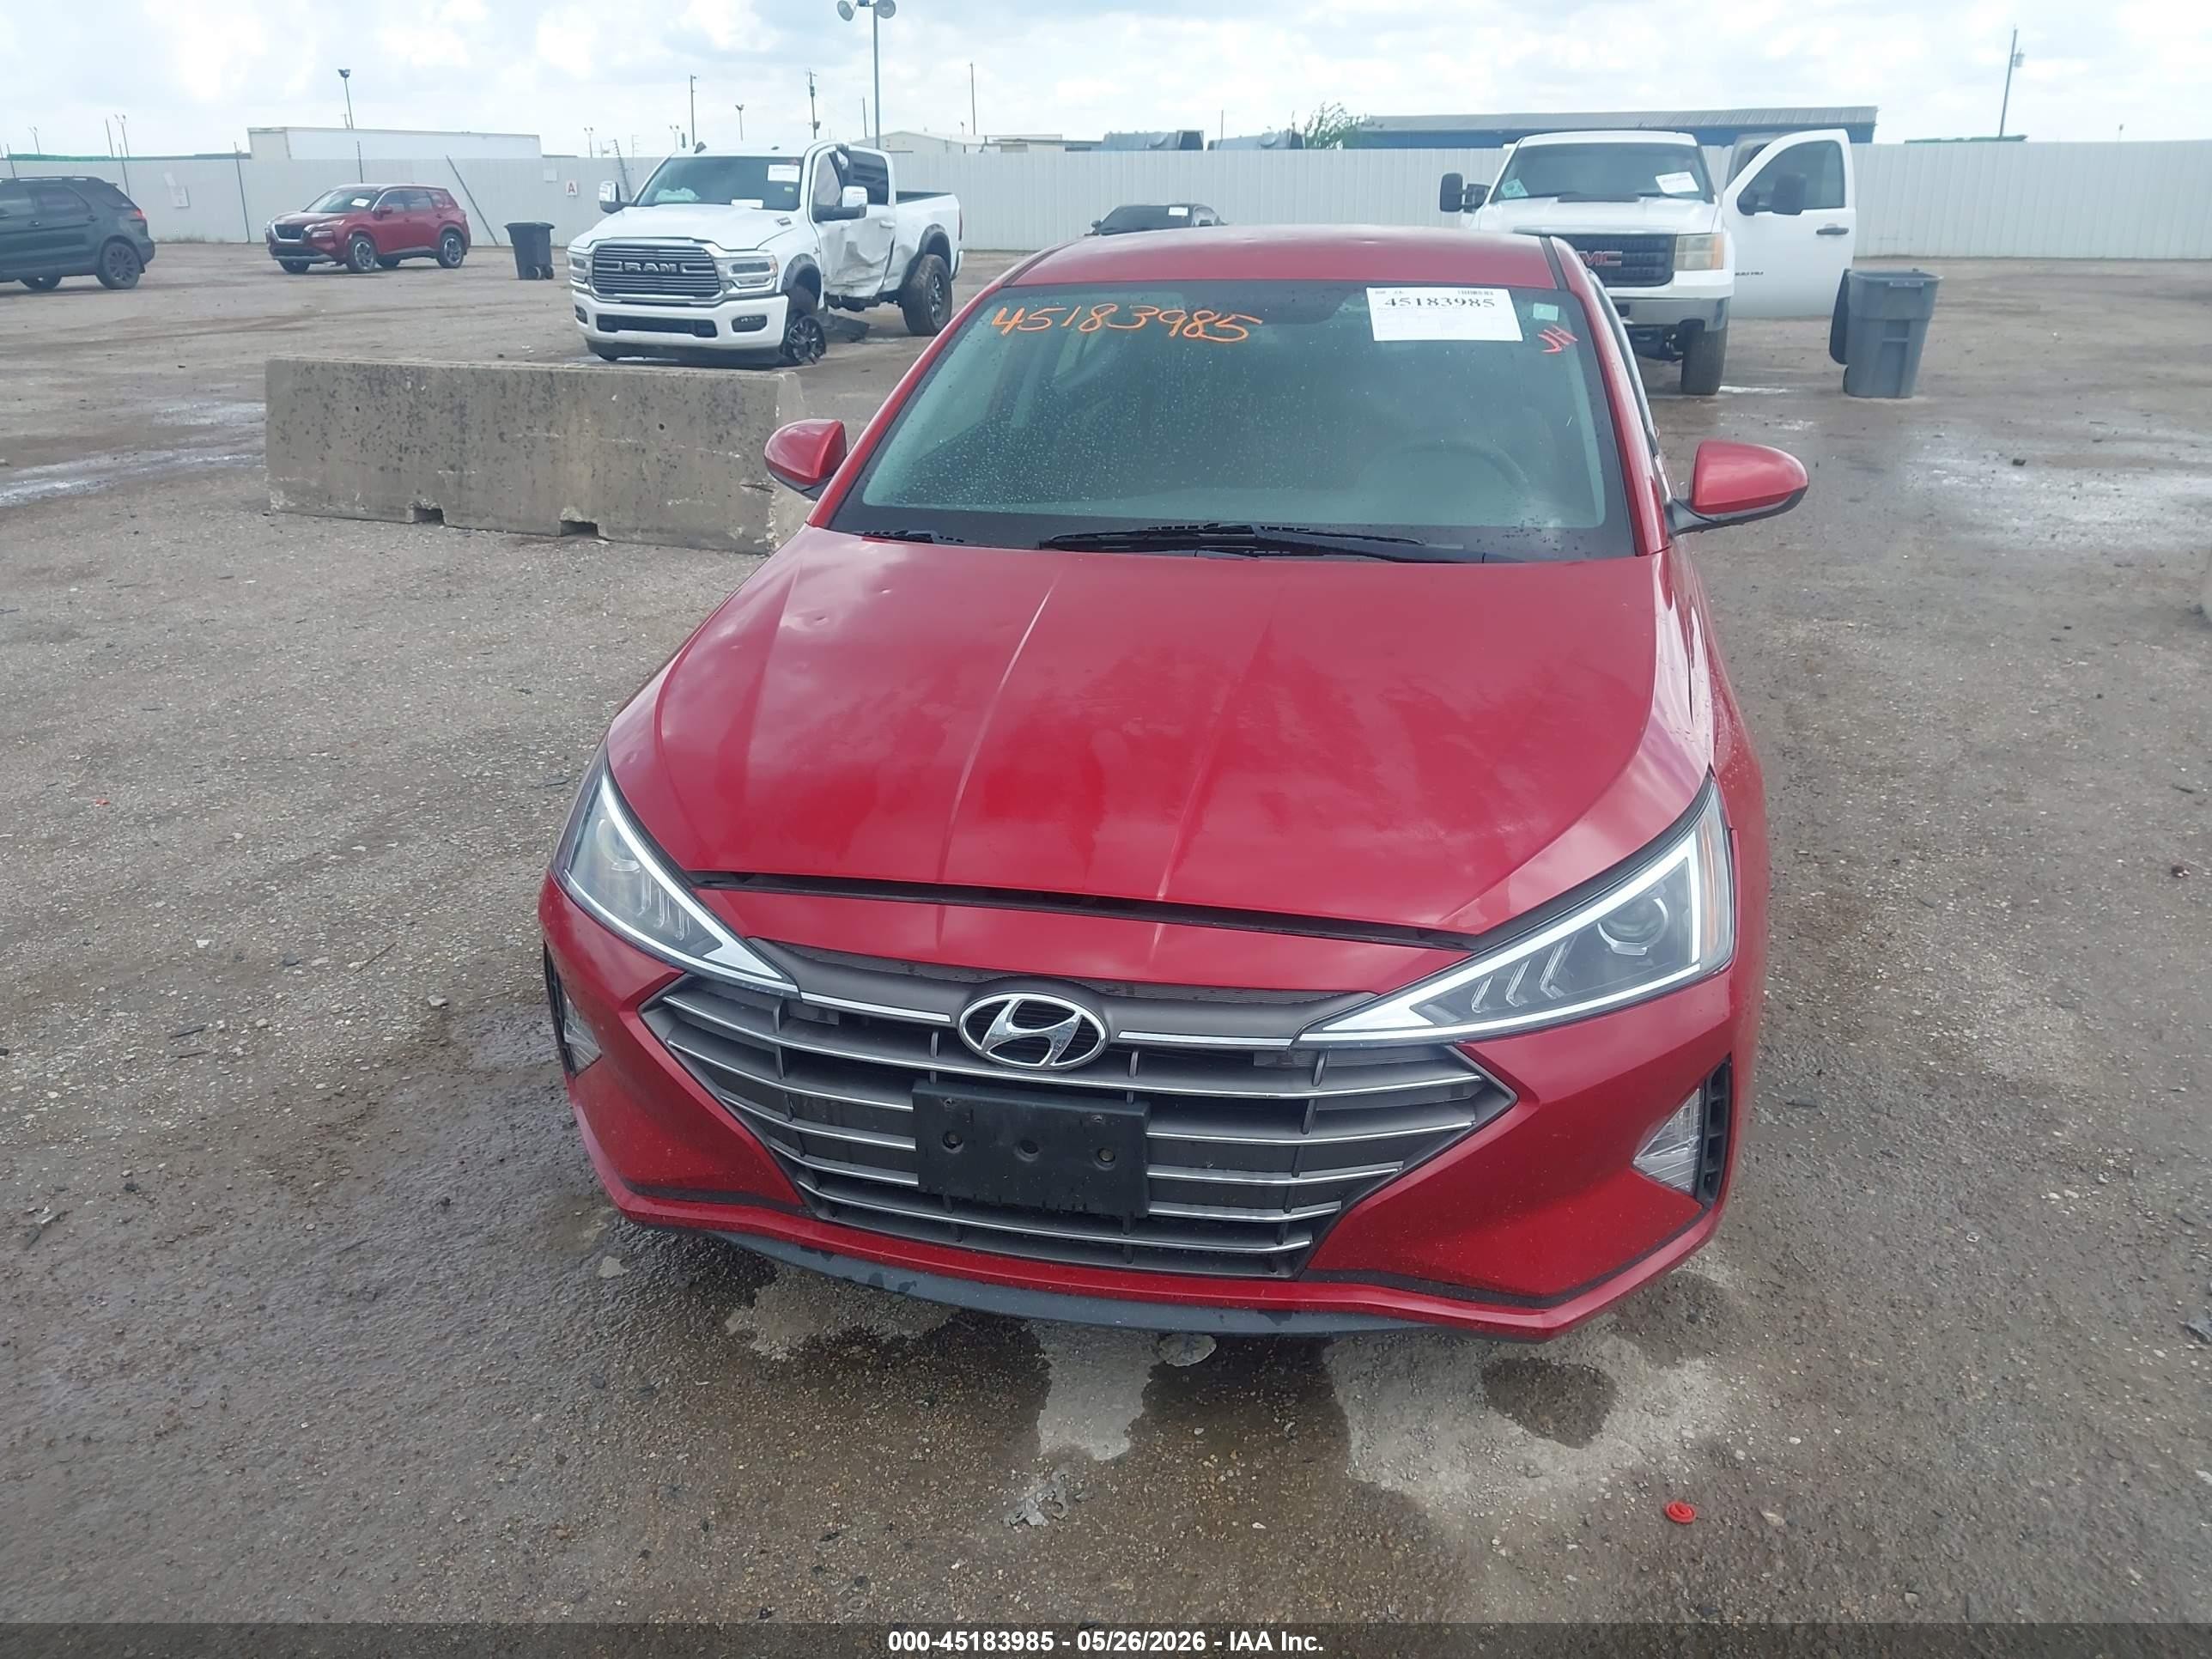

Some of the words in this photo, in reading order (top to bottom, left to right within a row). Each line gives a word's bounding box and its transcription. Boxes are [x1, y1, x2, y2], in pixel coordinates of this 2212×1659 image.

[568, 181, 576, 194] A
[1576, 250, 1623, 267] MC
[624, 261, 678, 273] RAM
[1384, 296, 1496, 308] 45183985
[991, 302, 1264, 343] 45183985
